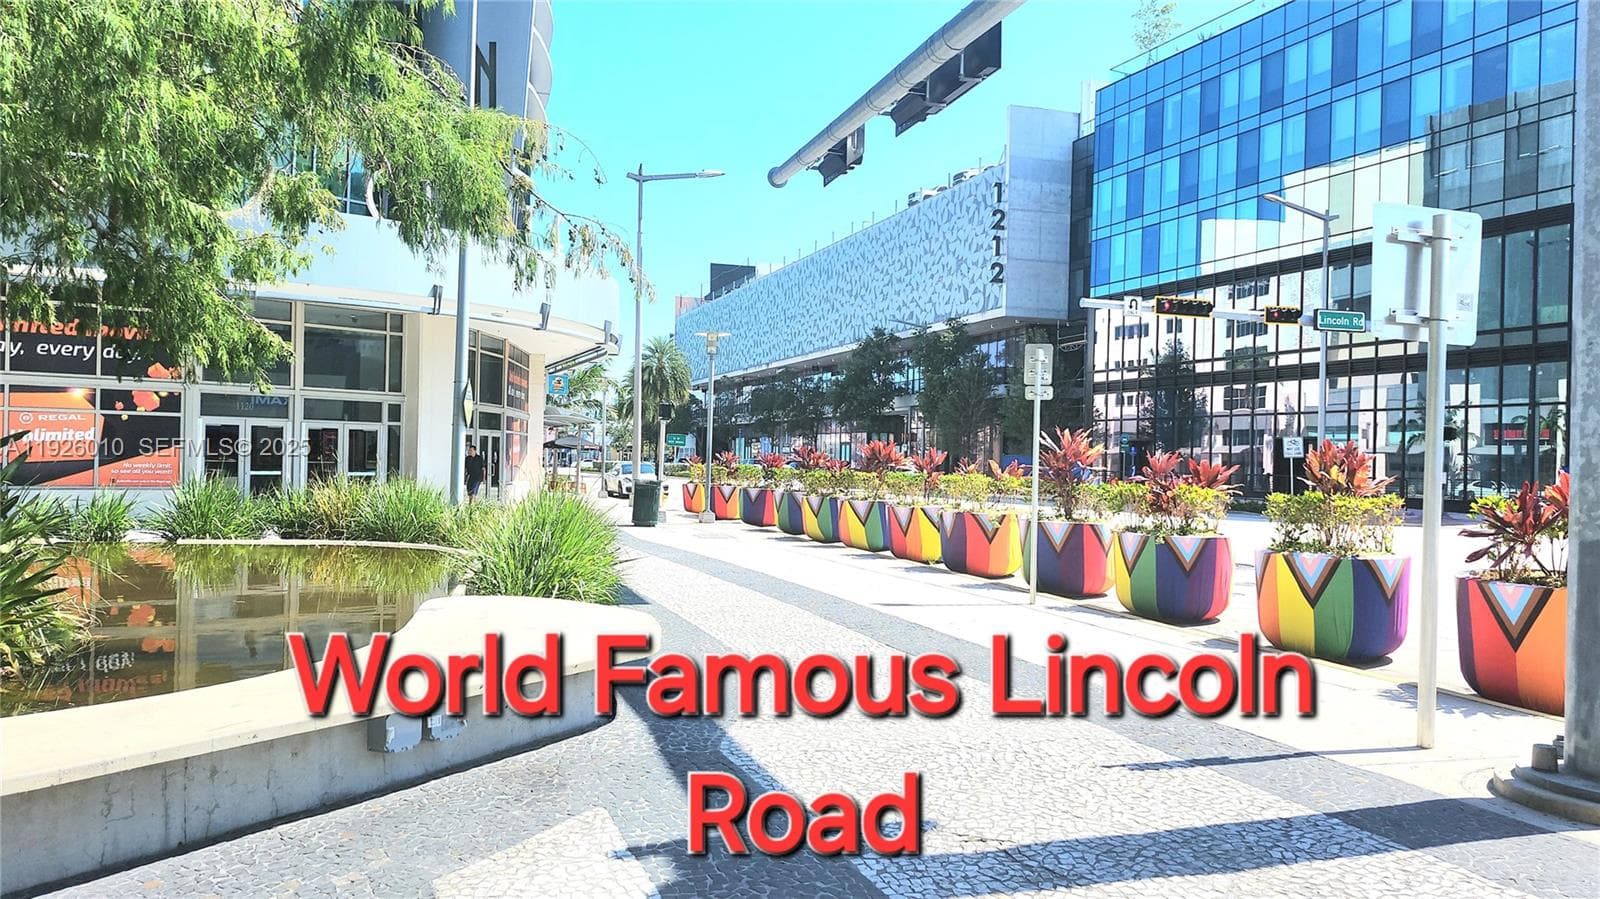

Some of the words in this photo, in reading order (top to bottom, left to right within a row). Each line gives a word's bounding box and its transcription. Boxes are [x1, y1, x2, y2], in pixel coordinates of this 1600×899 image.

[989, 182, 1006, 284] 1212
[1319, 315, 1349, 326] Lincoln
[1352, 316, 1363, 327] Rd
[36, 342, 95, 361] every
